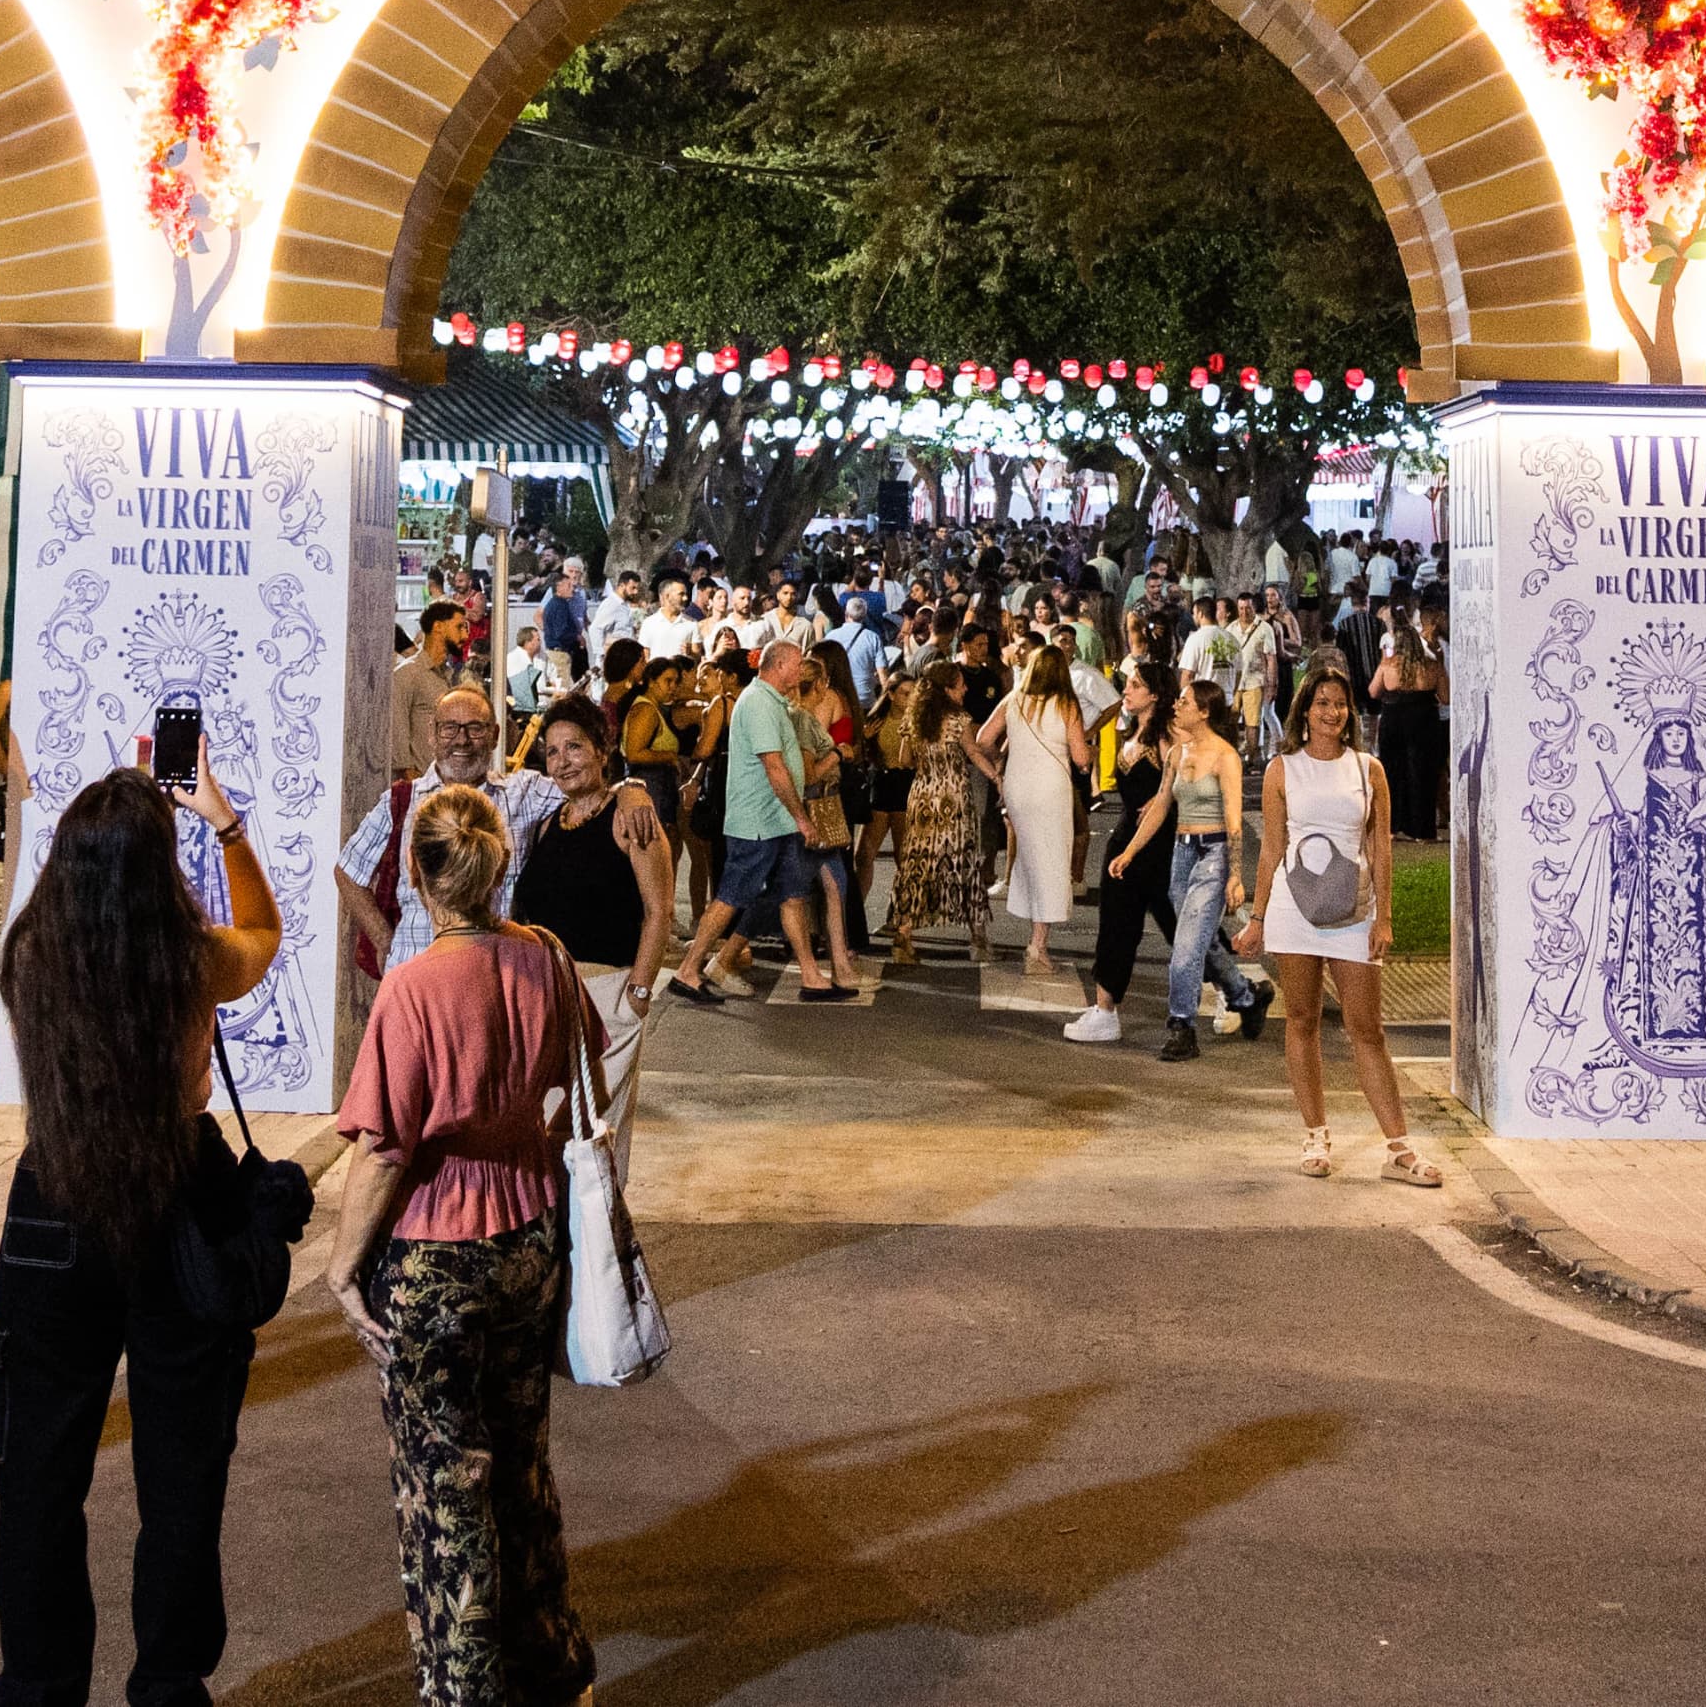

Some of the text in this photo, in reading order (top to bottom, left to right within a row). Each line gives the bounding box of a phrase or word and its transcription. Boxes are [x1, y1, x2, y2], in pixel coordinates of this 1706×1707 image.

[133, 406, 253, 479] VIVA
[117, 487, 253, 530] LA VIRGEN
[1599, 527, 1615, 545] LA
[111, 538, 251, 576] DEL CARMEN
[1596, 575, 1621, 595] DEL
